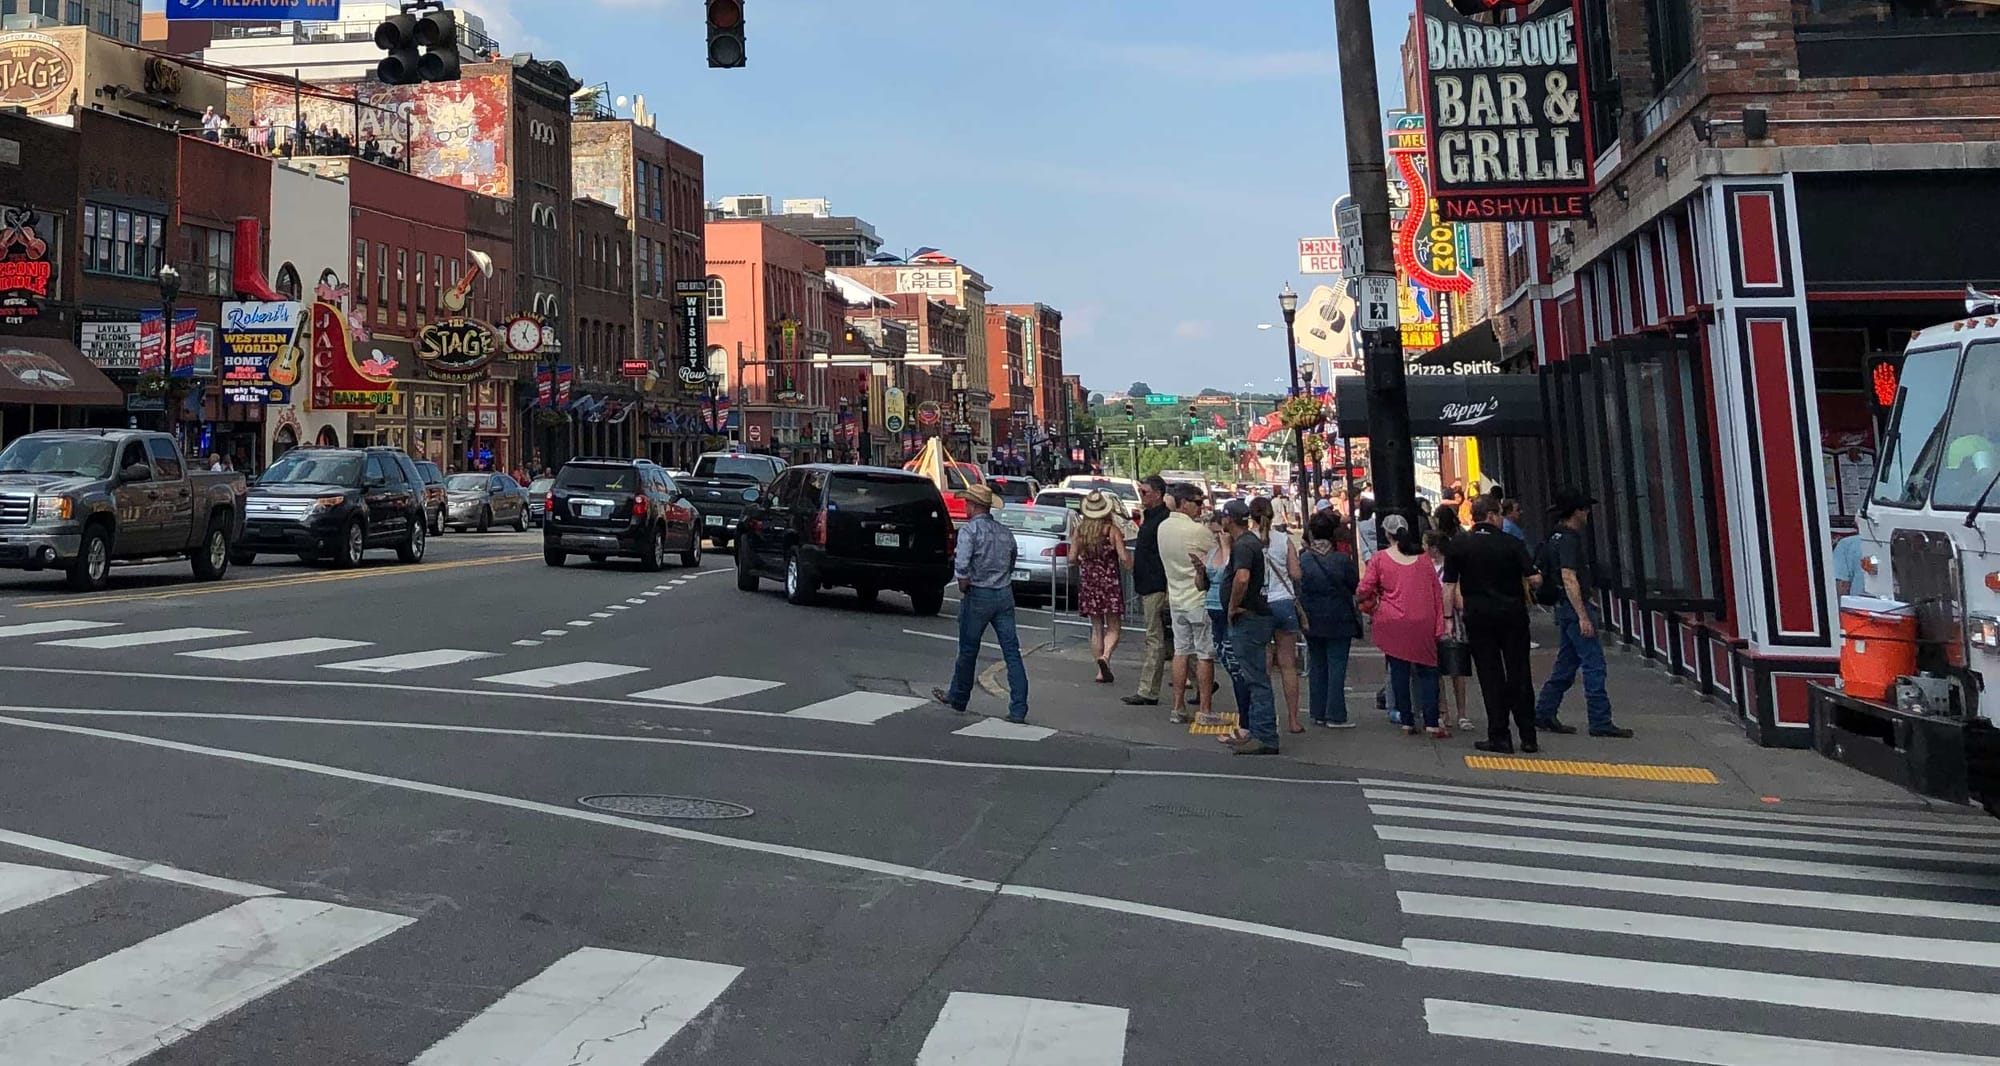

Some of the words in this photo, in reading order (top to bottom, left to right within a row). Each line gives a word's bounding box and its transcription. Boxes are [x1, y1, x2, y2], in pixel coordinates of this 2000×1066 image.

[1424, 7, 1577, 70] BARBEQUE
[10, 47, 31, 57] THE
[0, 57, 67, 91] TAGE
[1435, 72, 1533, 127] BAR
[1543, 70, 1580, 125] &
[1438, 127, 1585, 184] GRILL
[1446, 197, 1584, 218] NASHVILLE
[912, 272, 952, 280] OLE
[1368, 279, 1389, 287] CROSS
[448, 318, 465, 327] THE
[97, 325, 128, 333] LAYLA'S
[686, 297, 697, 367] WHISKEY
[95, 333, 131, 341] WELCOMES
[223, 334, 287, 343] WESTERN
[419, 324, 496, 360] STAGE
[232, 344, 278, 353] WORLD
[224, 356, 263, 366] HOME
[1408, 362, 1445, 375] Pizza
[1453, 360, 1500, 375] Spirits
[678, 365, 707, 383] Row
[233, 394, 259, 402] GRILL
[1439, 395, 1498, 421] Rippy's
